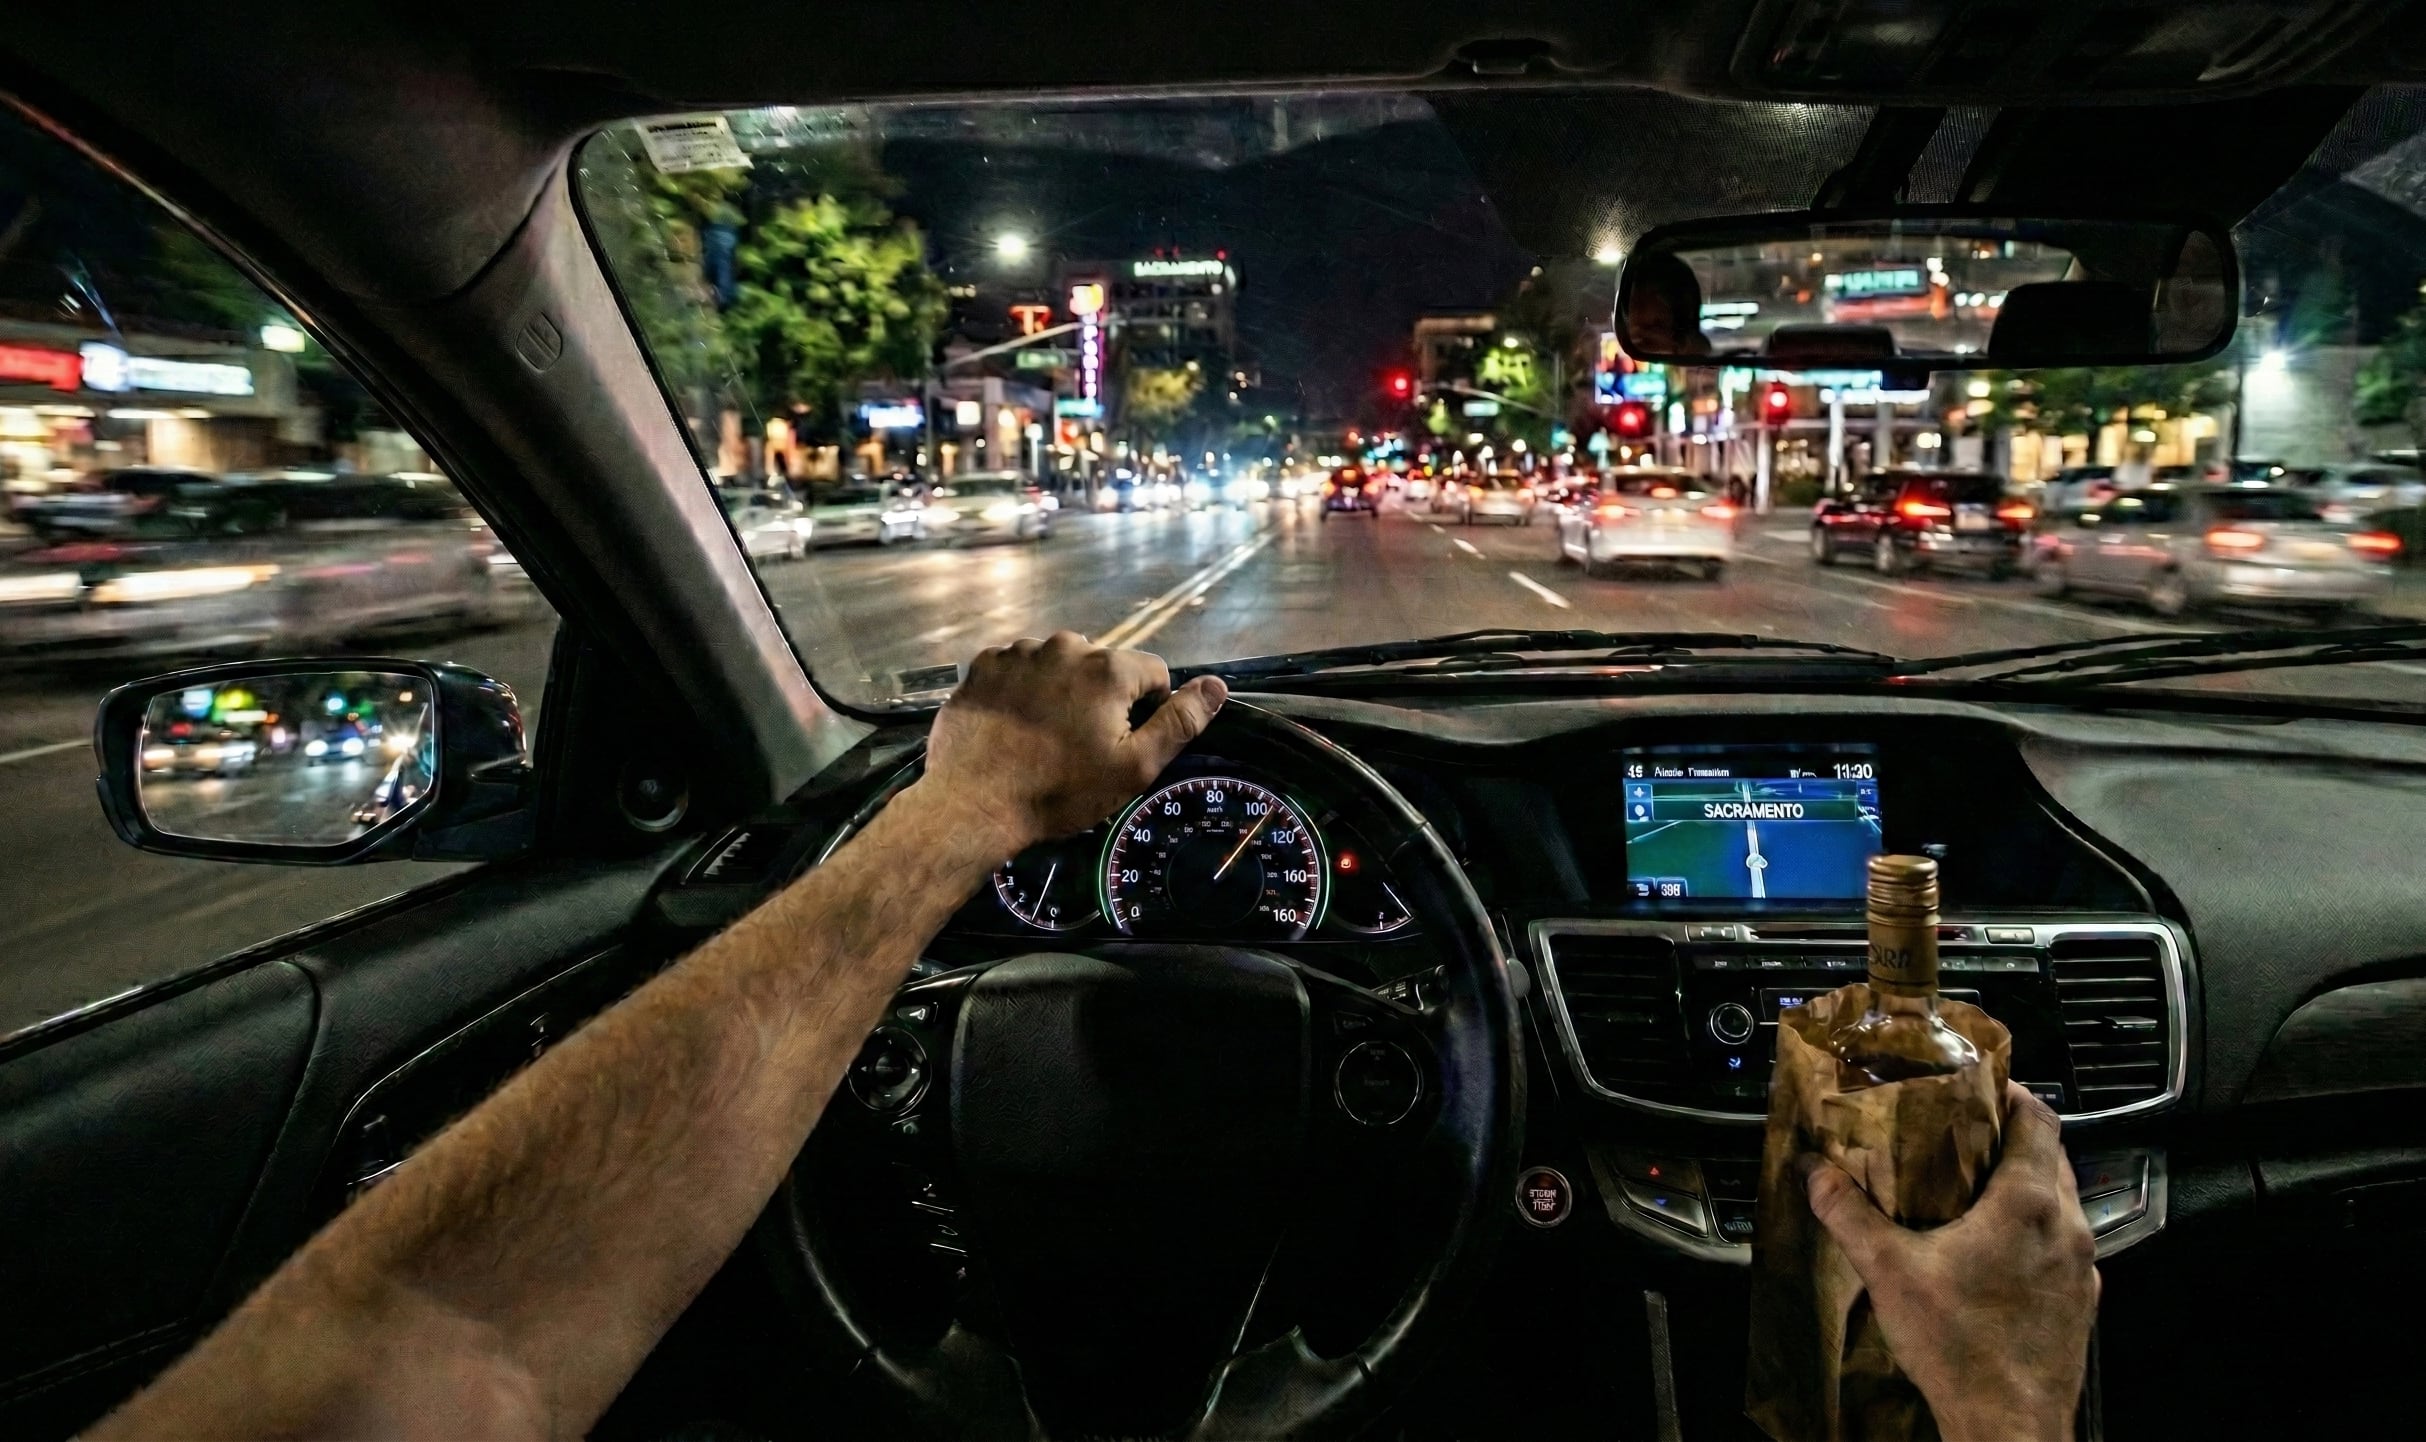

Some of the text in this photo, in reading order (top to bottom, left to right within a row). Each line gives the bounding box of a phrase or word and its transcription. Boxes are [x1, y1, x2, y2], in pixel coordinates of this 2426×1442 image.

[1206, 790, 1225, 803] 80
[1245, 802, 1268, 816] 100
[1704, 803, 1804, 819] SACRAMENTO
[1133, 828, 1150, 843] 40
[1271, 830, 1295, 845] 120
[1121, 870, 1139, 884] 20
[1283, 869, 1308, 883] 160
[1272, 908, 1297, 922] 160
